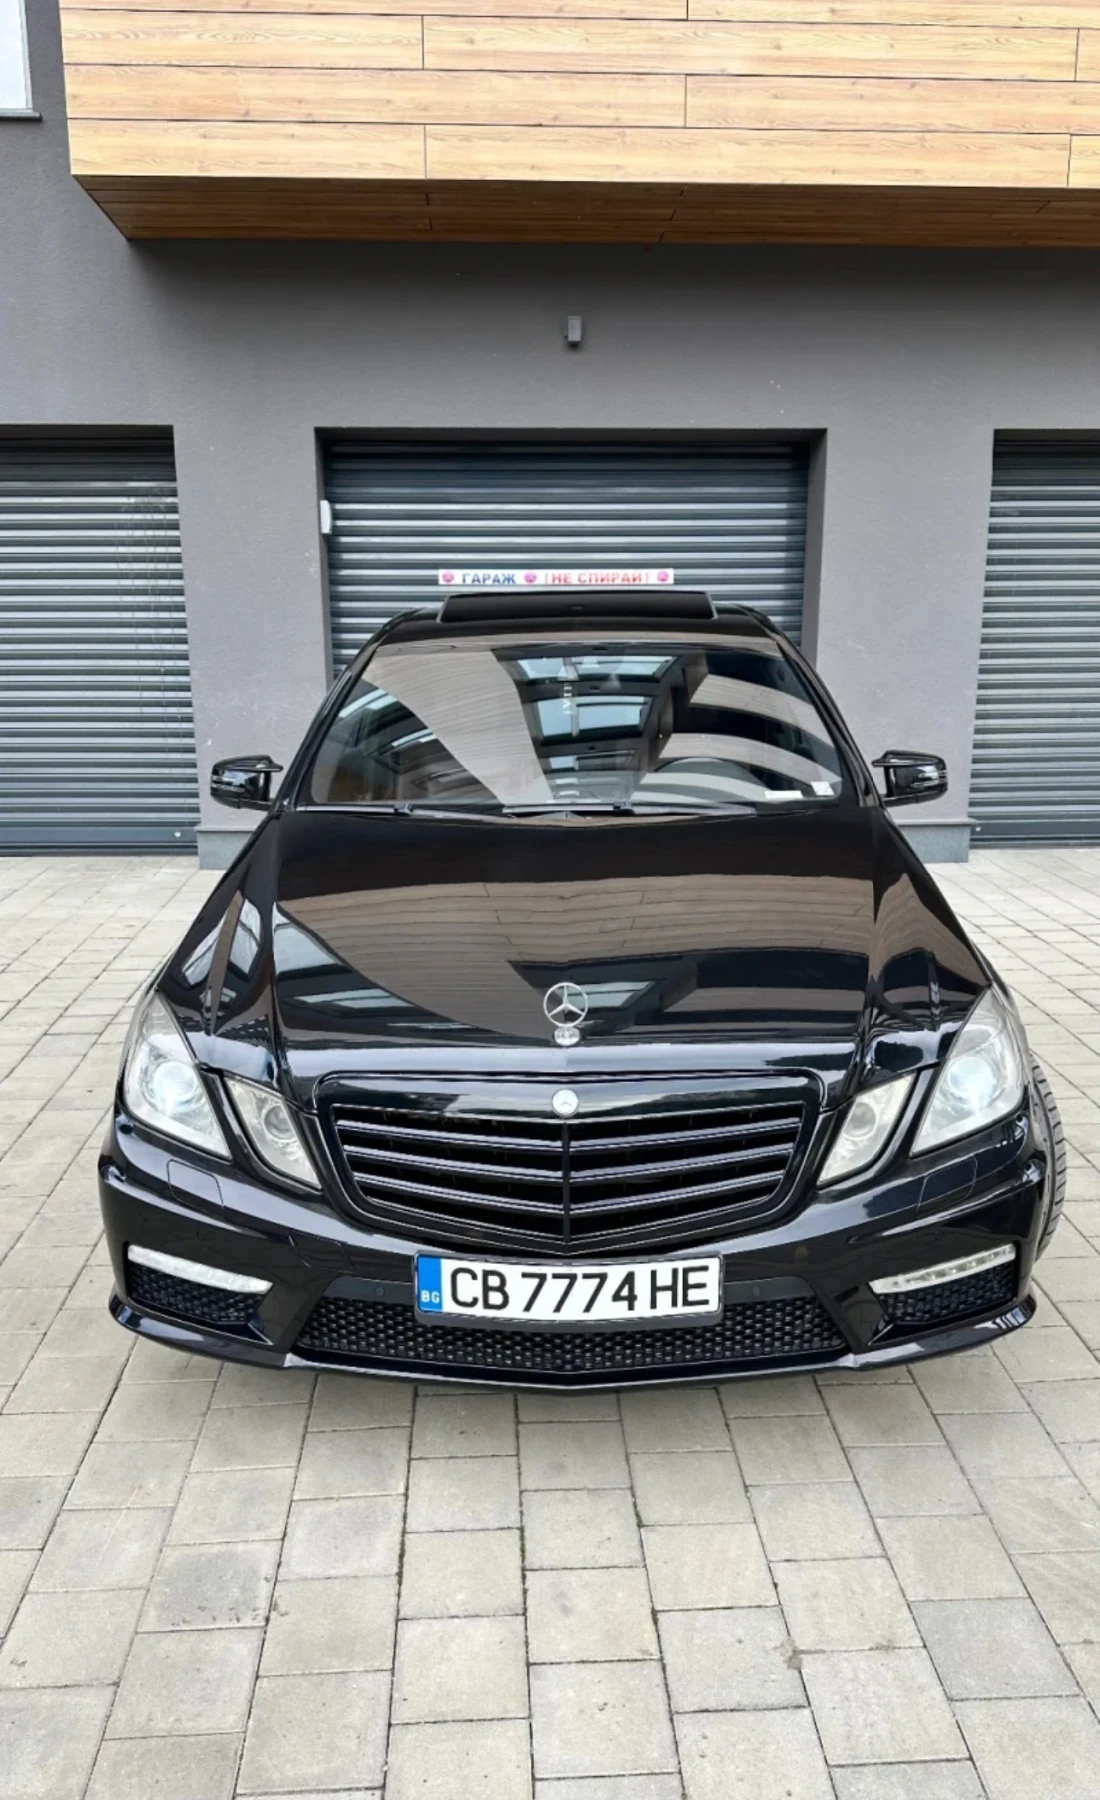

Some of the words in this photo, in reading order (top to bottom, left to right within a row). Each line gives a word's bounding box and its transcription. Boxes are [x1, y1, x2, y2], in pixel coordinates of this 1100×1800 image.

[462, 572, 517, 585] ГАРАЖ
[421, 1290, 440, 1304] BG
[450, 1266, 510, 1310] CB
[521, 1270, 638, 1313] 7774
[650, 1265, 711, 1310] HE
